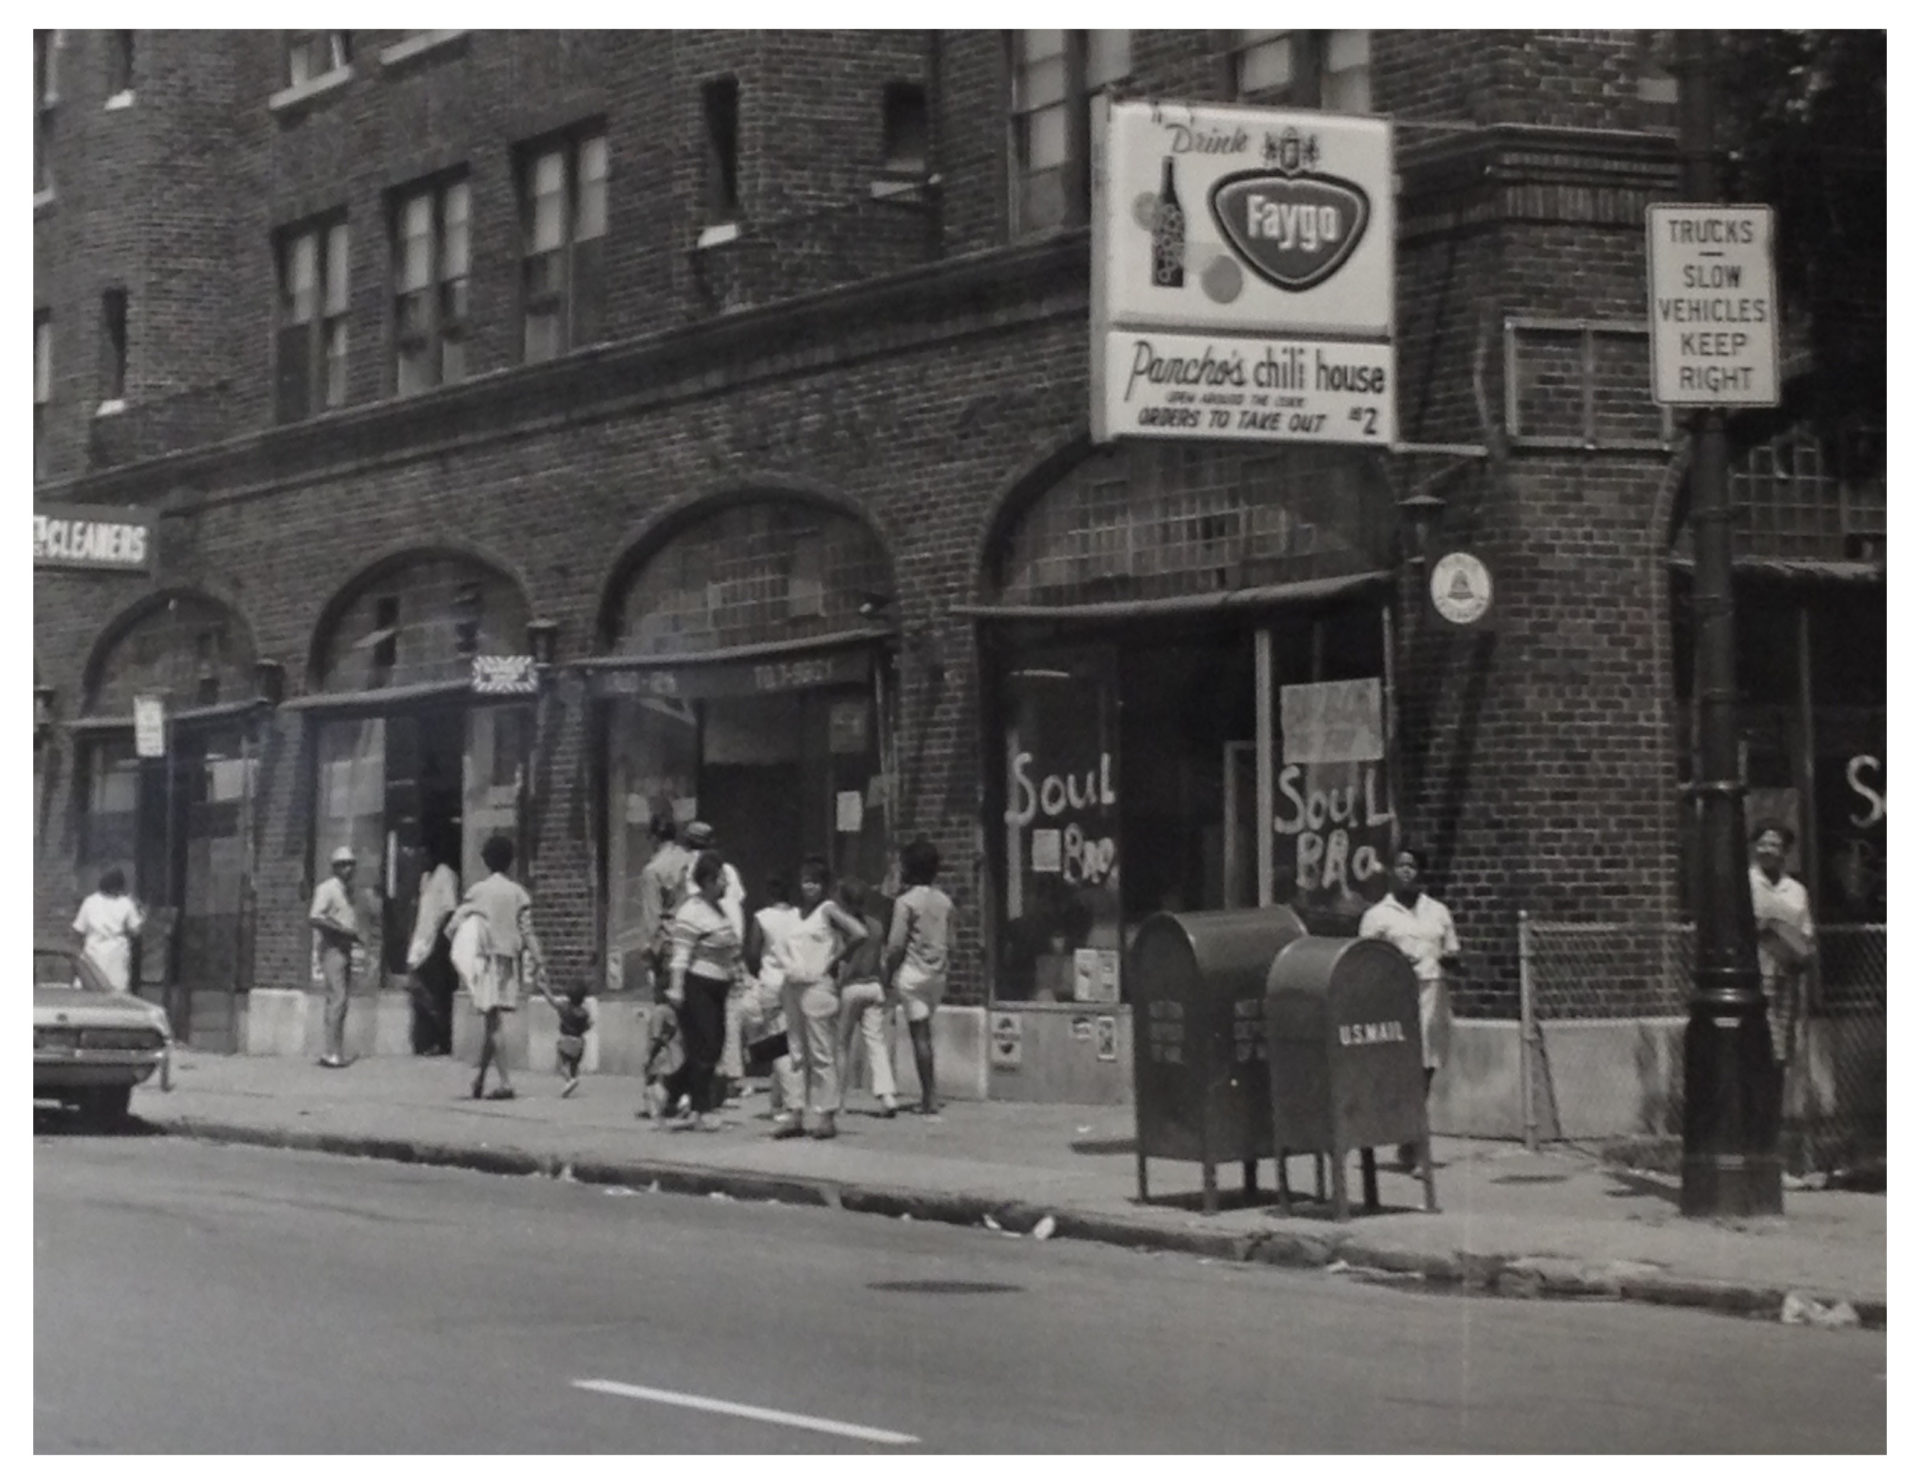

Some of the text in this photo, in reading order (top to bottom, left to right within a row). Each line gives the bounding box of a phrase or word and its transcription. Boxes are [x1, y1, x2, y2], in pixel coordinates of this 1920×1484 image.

[1165, 123, 1248, 154] Drink
[1246, 194, 1341, 250] Faygo
[1668, 218, 1753, 244] TRUCKS
[1683, 264, 1741, 288] SLOW
[1657, 298, 1766, 322] VEHICLES
[1681, 332, 1748, 356] KEEP
[1124, 339, 1385, 402] Pancho's chili house
[1679, 366, 1754, 392] RIGHT
[1138, 406, 1201, 428] ORDERS
[1208, 409, 1230, 428] TO
[1237, 410, 1282, 431] TAKE
[1288, 413, 1327, 433] OUT
[47, 518, 146, 562] CLEANERS
[1846, 754, 1887, 828] S
